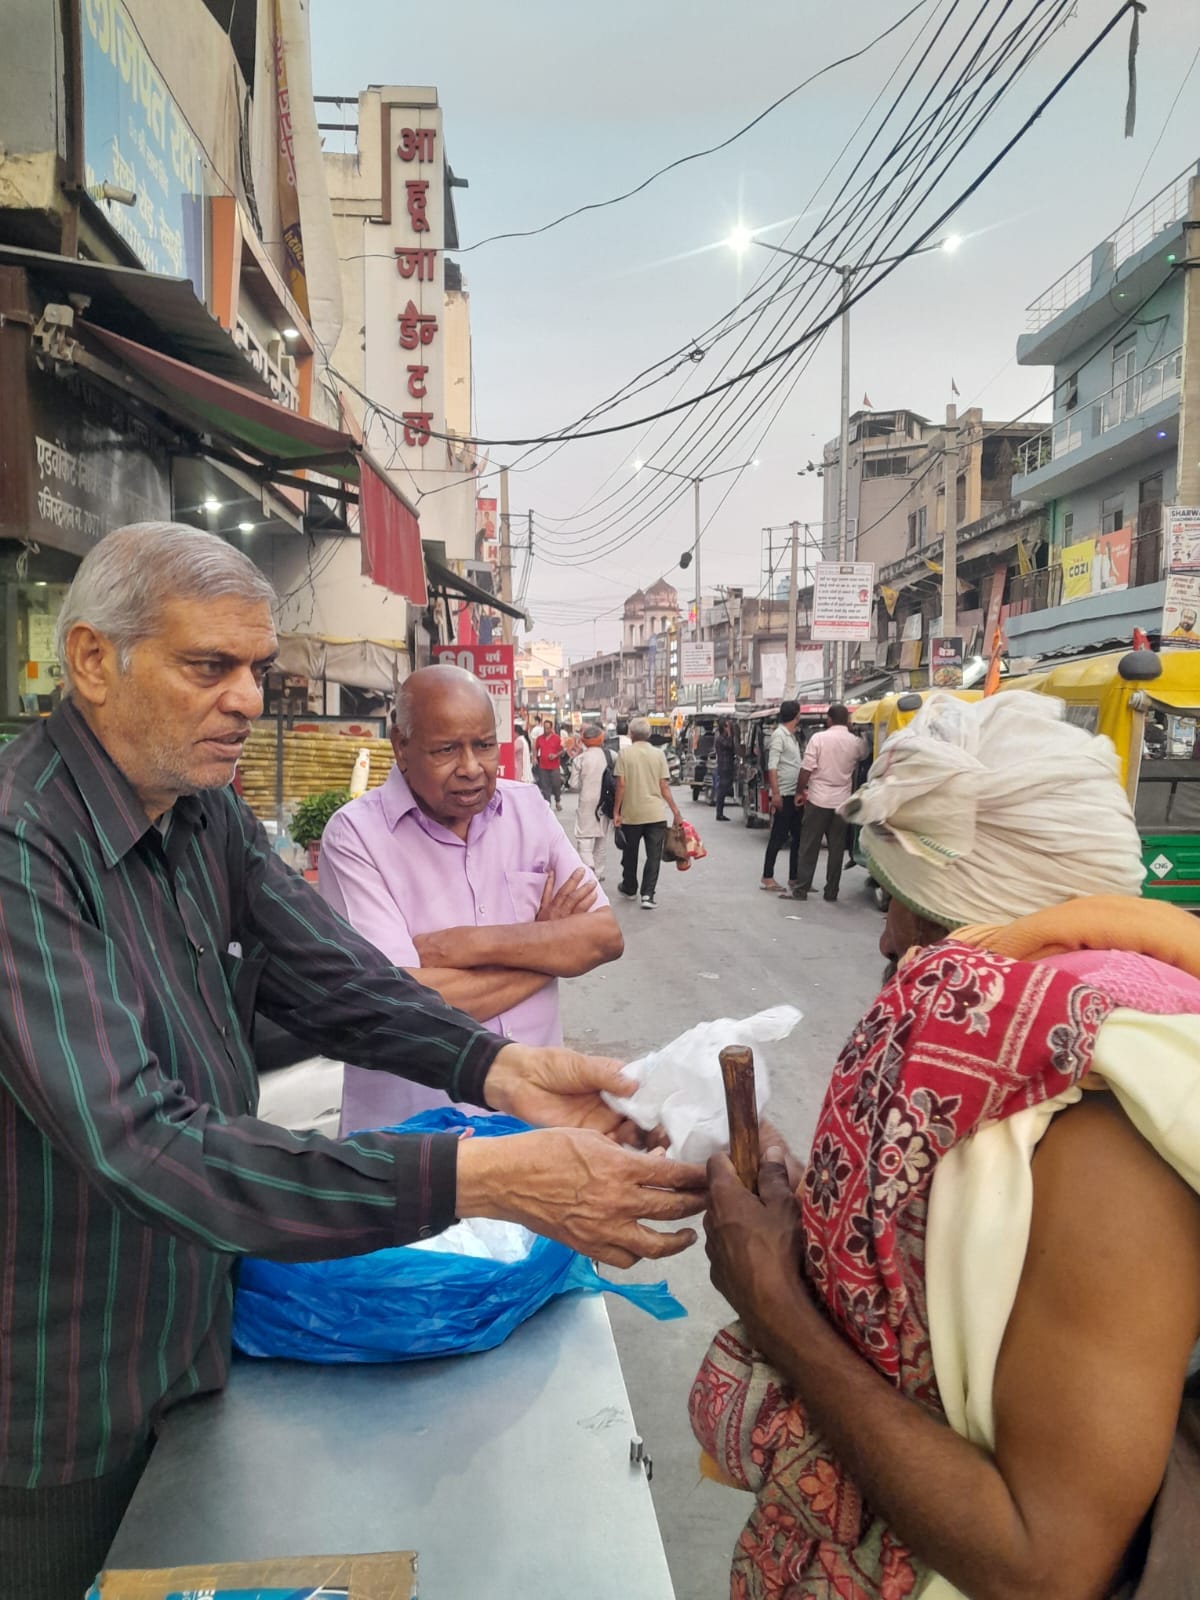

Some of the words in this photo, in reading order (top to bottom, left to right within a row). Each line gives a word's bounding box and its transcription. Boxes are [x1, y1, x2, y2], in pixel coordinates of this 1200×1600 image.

[394, 127, 437, 282] आहूजा
[1171, 509, 1200, 517] SHARW
[1069, 561, 1089, 578] COZI
[485, 651, 501, 662] वर्ष
[478, 665, 508, 678] पुराना
[1154, 862, 1168, 870] CNG
